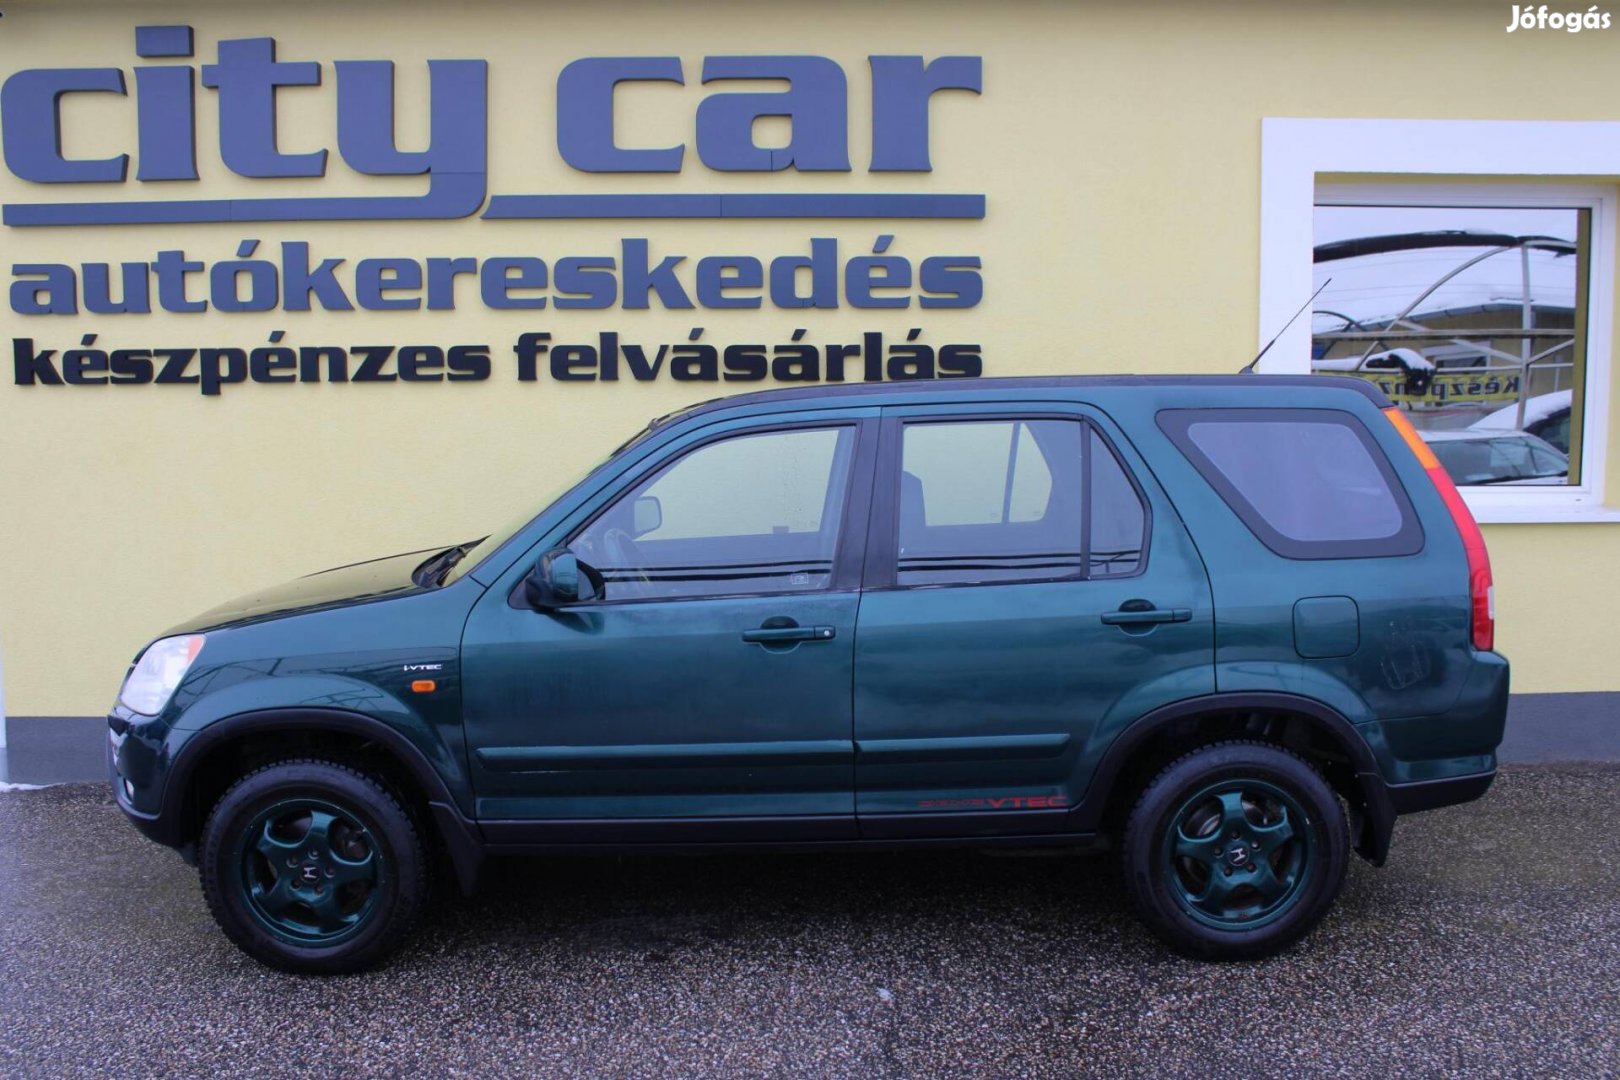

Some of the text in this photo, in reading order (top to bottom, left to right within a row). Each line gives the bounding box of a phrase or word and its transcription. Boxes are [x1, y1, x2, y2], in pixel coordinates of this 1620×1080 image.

[0, 25, 983, 220] city car
[9, 234, 984, 315] autókereskedés
[12, 327, 983, 396] készpénzes felvásárlás
